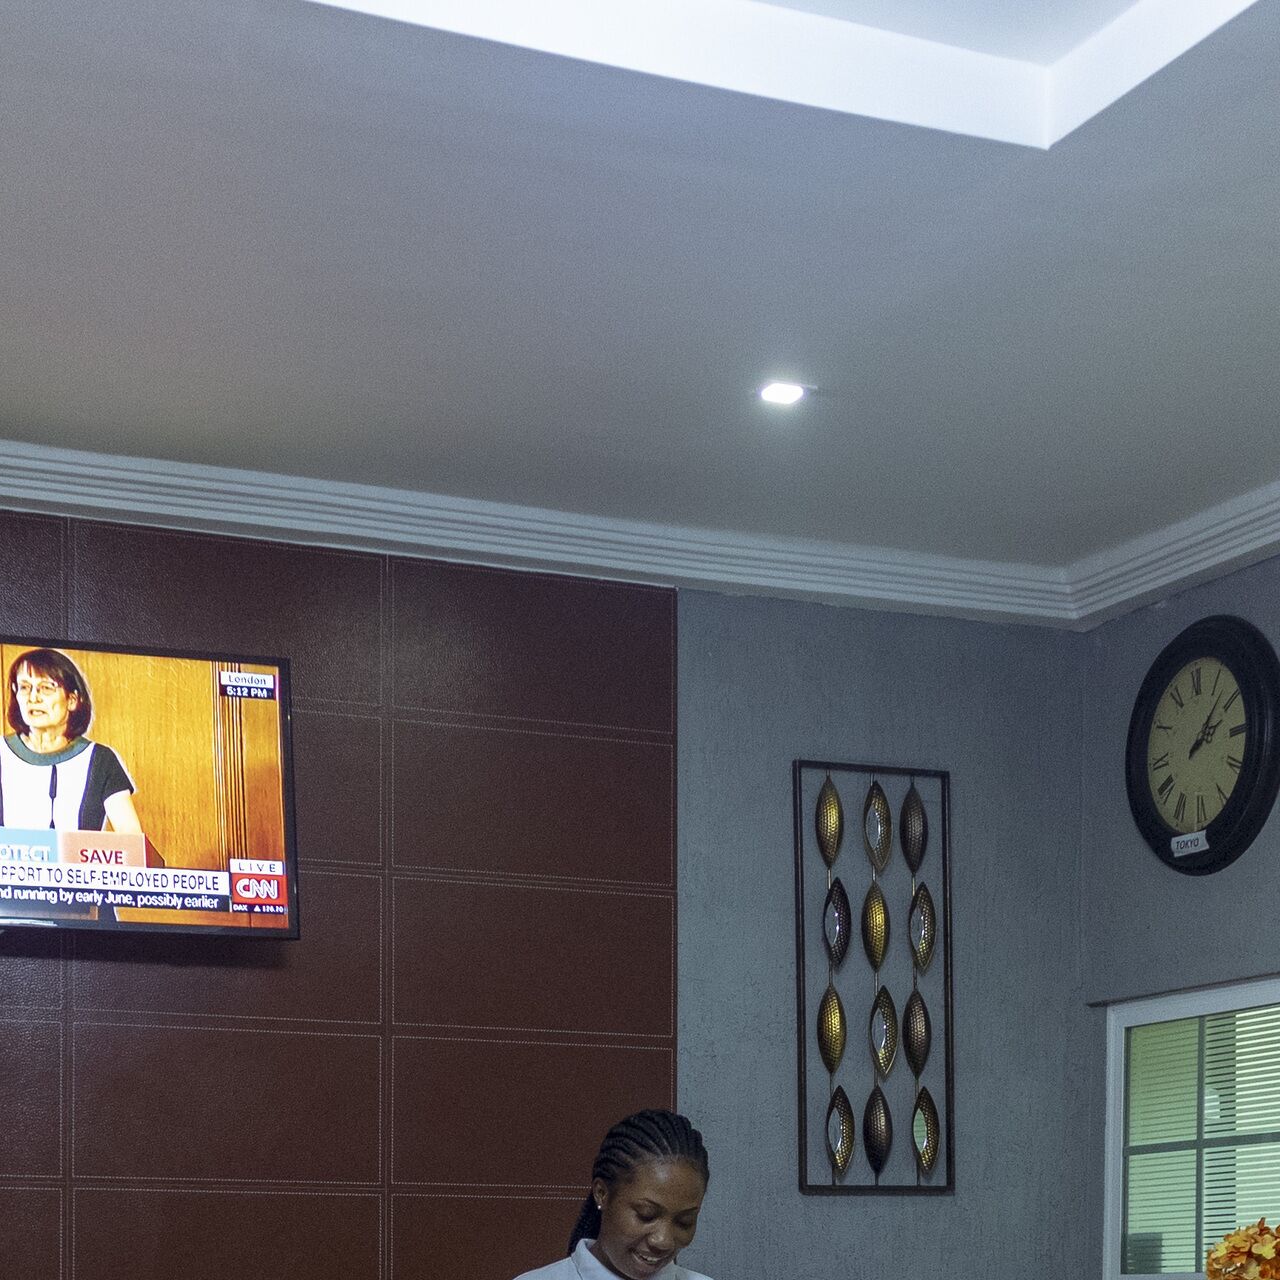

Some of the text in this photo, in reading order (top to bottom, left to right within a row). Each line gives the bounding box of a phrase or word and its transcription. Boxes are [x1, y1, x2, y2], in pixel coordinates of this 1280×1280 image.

[228, 675, 267, 685] London
[250, 688, 268, 698] PM
[1176, 838, 1200, 850] TOKYO
[79, 849, 123, 864] SAVE
[238, 862, 276, 873] LIVE
[46, 868, 63, 883] TO
[66, 868, 168, 888] SELF-EMPLOYED
[172, 875, 219, 891] PEOPLE
[235, 878, 279, 899] CNN
[13, 889, 58, 904] running
[58, 889, 75, 905] by
[75, 891, 104, 906] early
[105, 893, 136, 906] June,
[137, 893, 182, 909] possibly
[184, 896, 219, 909] earlier
